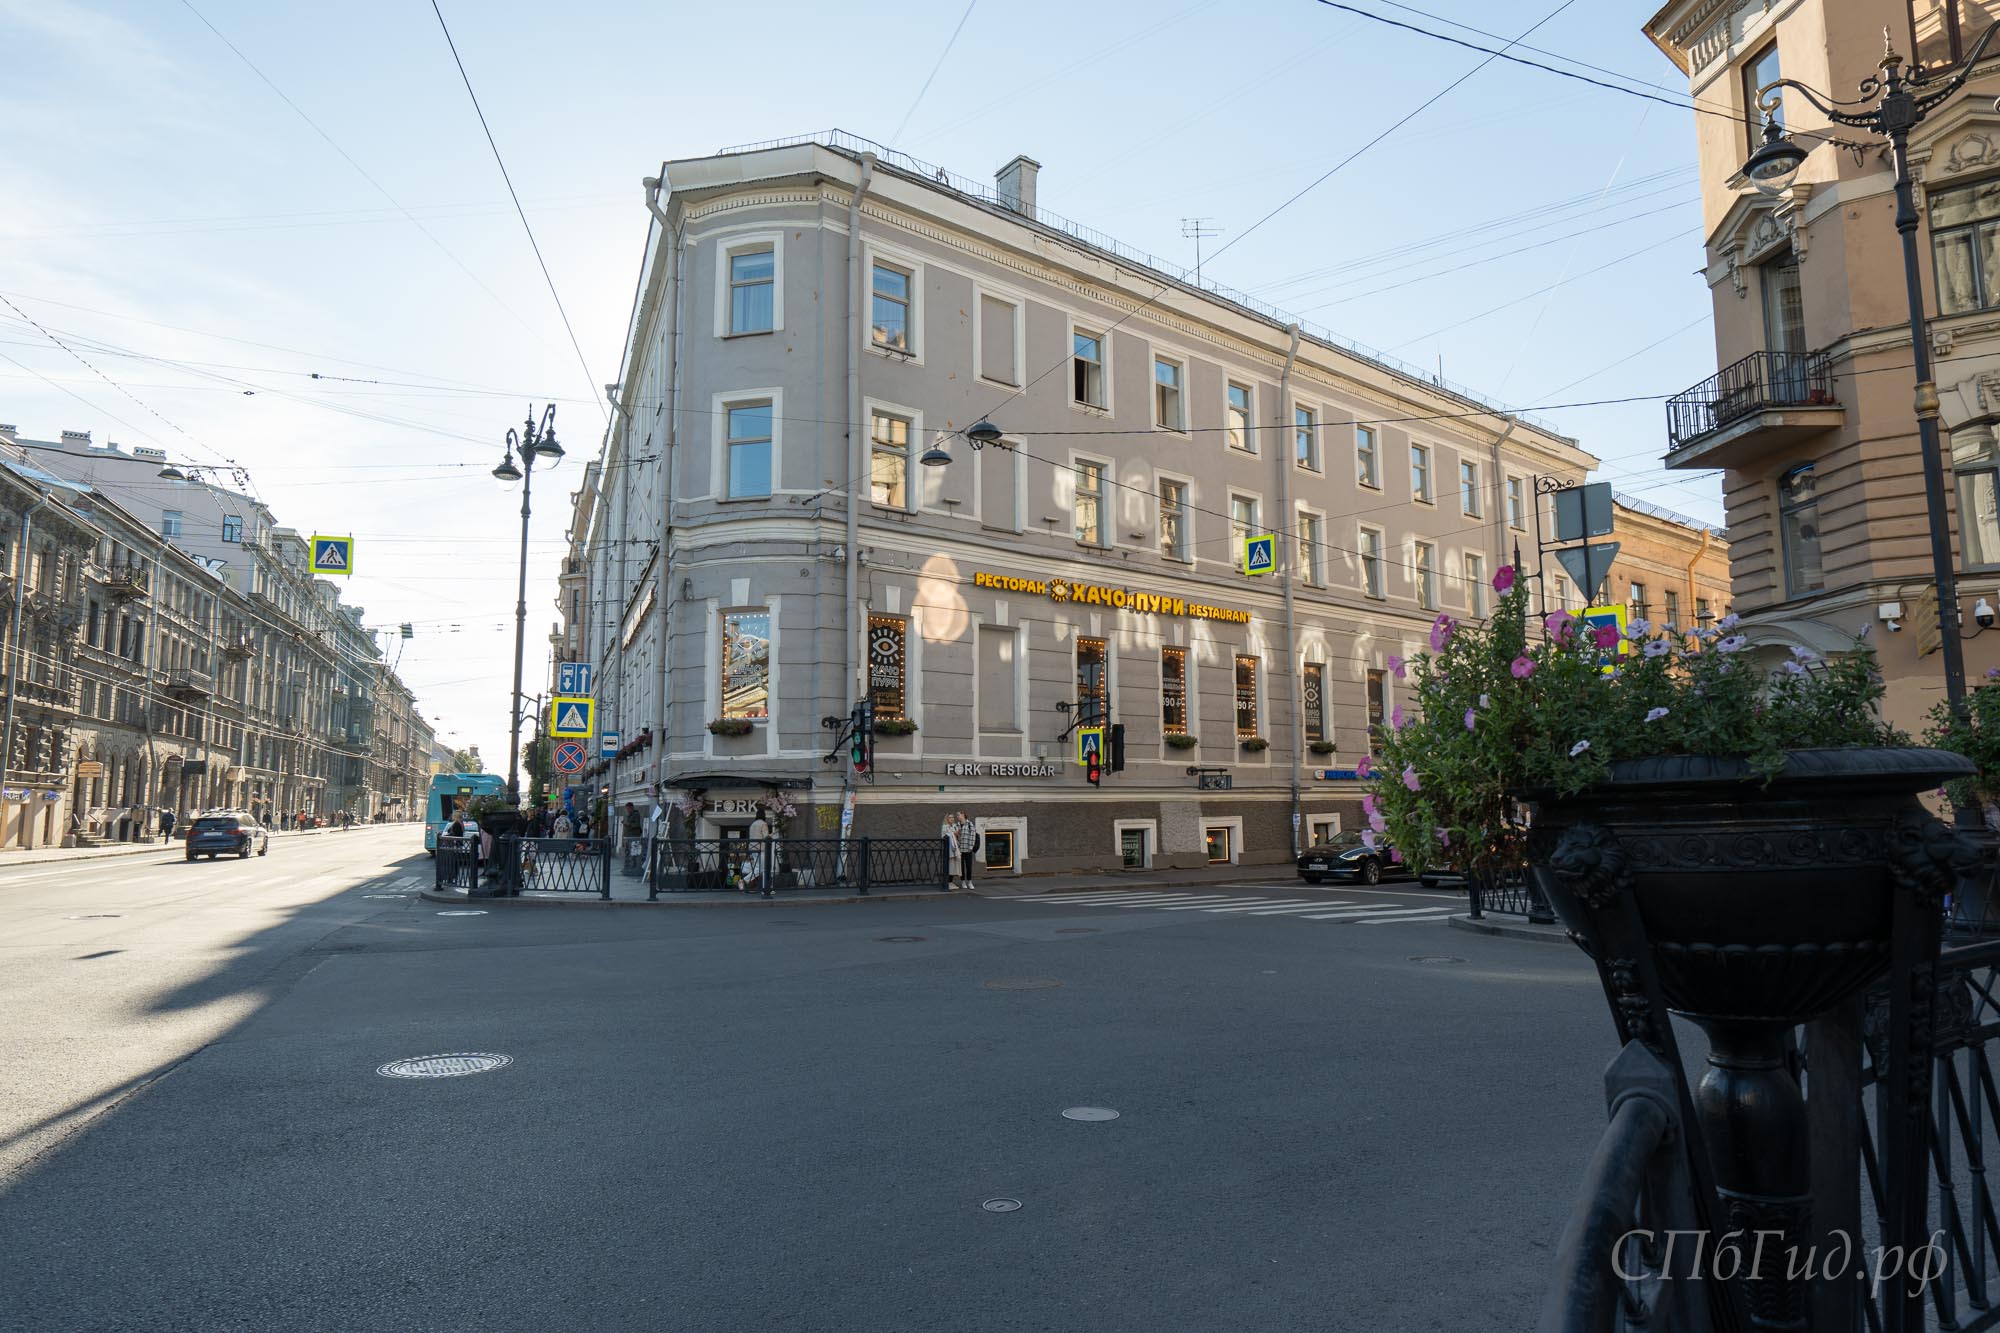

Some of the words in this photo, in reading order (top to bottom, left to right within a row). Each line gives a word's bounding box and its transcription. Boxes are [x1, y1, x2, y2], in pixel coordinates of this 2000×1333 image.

[975, 572, 1046, 595] РЕСТОРАН
[1071, 583, 1126, 608] ХАЧО
[1135, 592, 1184, 616] ПУРИ
[1188, 603, 1252, 624] RESTAURANT
[946, 763, 982, 776] FORK
[990, 764, 1056, 777] RESTOBAR
[714, 799, 759, 813] FORK
